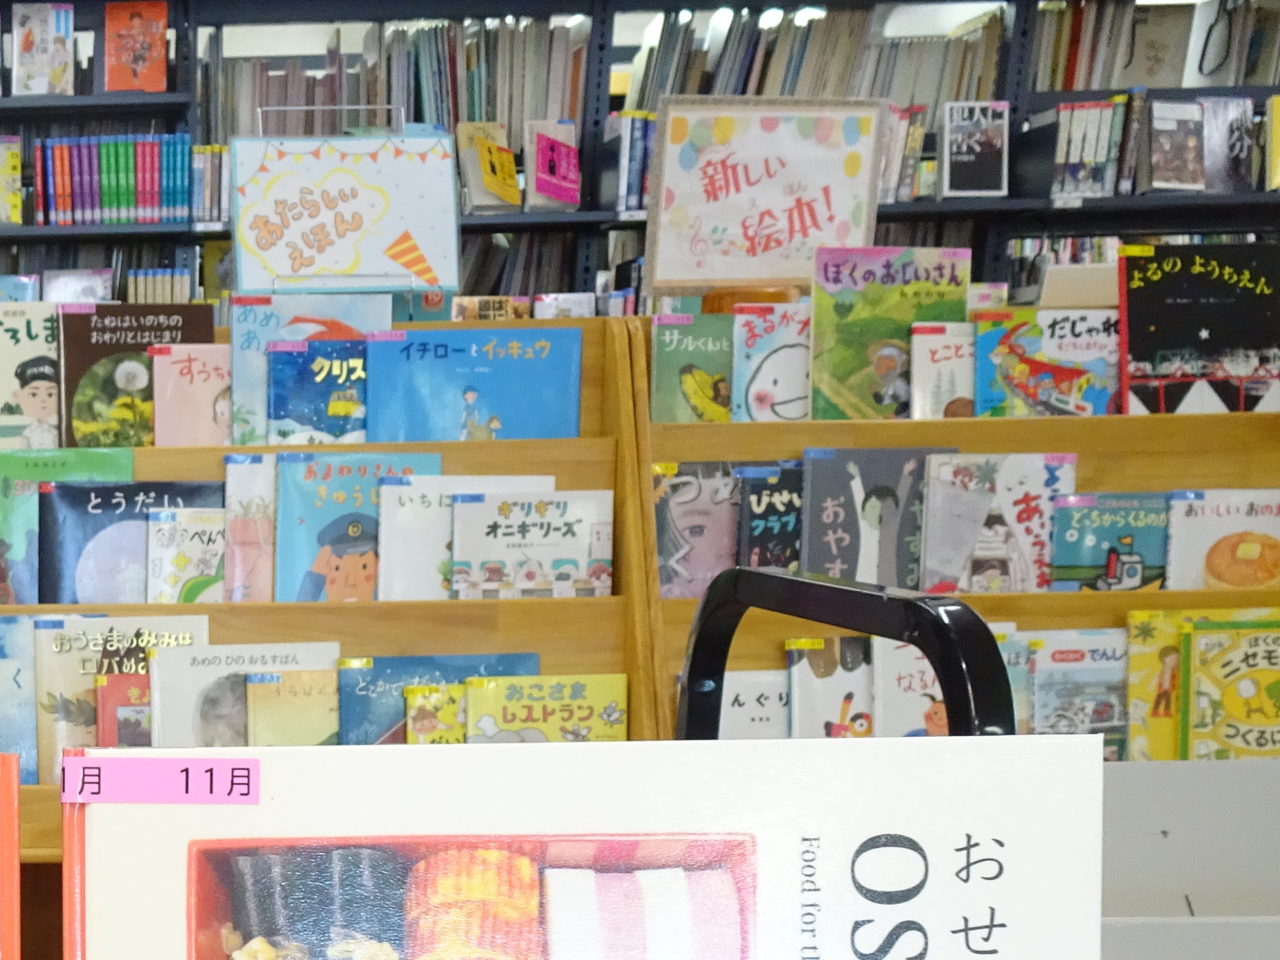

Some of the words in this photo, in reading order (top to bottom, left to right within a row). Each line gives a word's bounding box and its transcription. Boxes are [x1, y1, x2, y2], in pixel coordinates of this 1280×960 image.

[699, 152, 787, 203] 新しい
[250, 187, 358, 250] あたらしい
[741, 185, 836, 257] 絵本!
[286, 211, 363, 273] えほん
[823, 259, 963, 287] ぼくのおじいさん
[1130, 256, 1182, 289] よるの
[1190, 255, 1273, 296] ようちえん
[91, 314, 183, 328] たねはいのちの
[237, 305, 280, 329] あめ
[1048, 316, 1121, 339] だじゃれ
[91, 330, 183, 344] おわりとはじまり
[661, 328, 730, 351] サルくんと
[311, 356, 366, 384] クリス
[304, 462, 416, 481] おまわりさんの
[87, 491, 185, 514] とうだい
[498, 500, 569, 519] ギリギリ
[1185, 502, 1241, 518] おいしい
[485, 519, 583, 539] オニギリーズ
[52, 629, 194, 652] おうさまのみみは
[505, 682, 587, 701] おこさま
[502, 704, 594, 724] レストラン
[180, 766, 251, 797] 11月
[800, 836, 821, 894] Food
[800, 902, 821, 938] for
